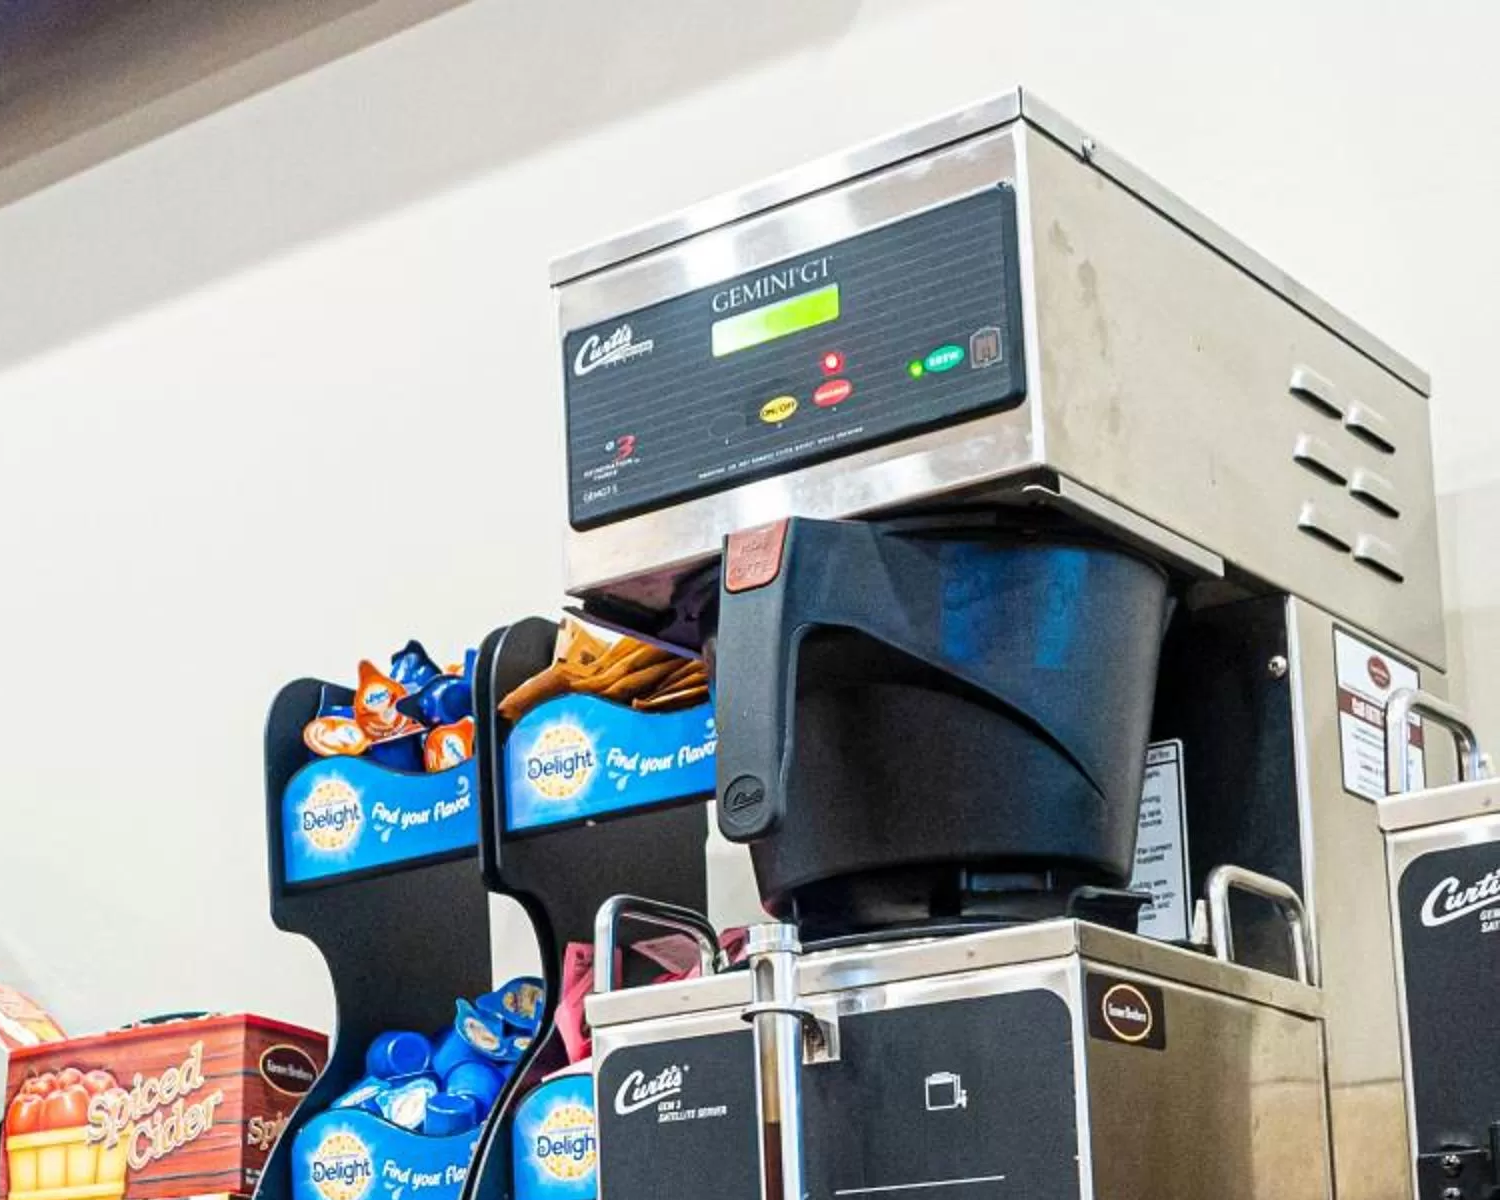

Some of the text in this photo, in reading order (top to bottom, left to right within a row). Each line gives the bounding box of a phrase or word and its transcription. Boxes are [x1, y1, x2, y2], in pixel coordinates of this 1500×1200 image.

[527, 749, 595, 781] Delight
[606, 746, 639, 772] Find
[639, 753, 675, 778] your
[302, 804, 362, 832] Delight
[371, 801, 400, 826] Find
[401, 808, 432, 832] your
[86, 1039, 205, 1150] Spiced
[614, 1065, 683, 1115] Curtis
[127, 1088, 224, 1171] Cider
[247, 1110, 289, 1151] Spi
[312, 1159, 372, 1186] Delight
[382, 1158, 470, 1191] Find your fla
